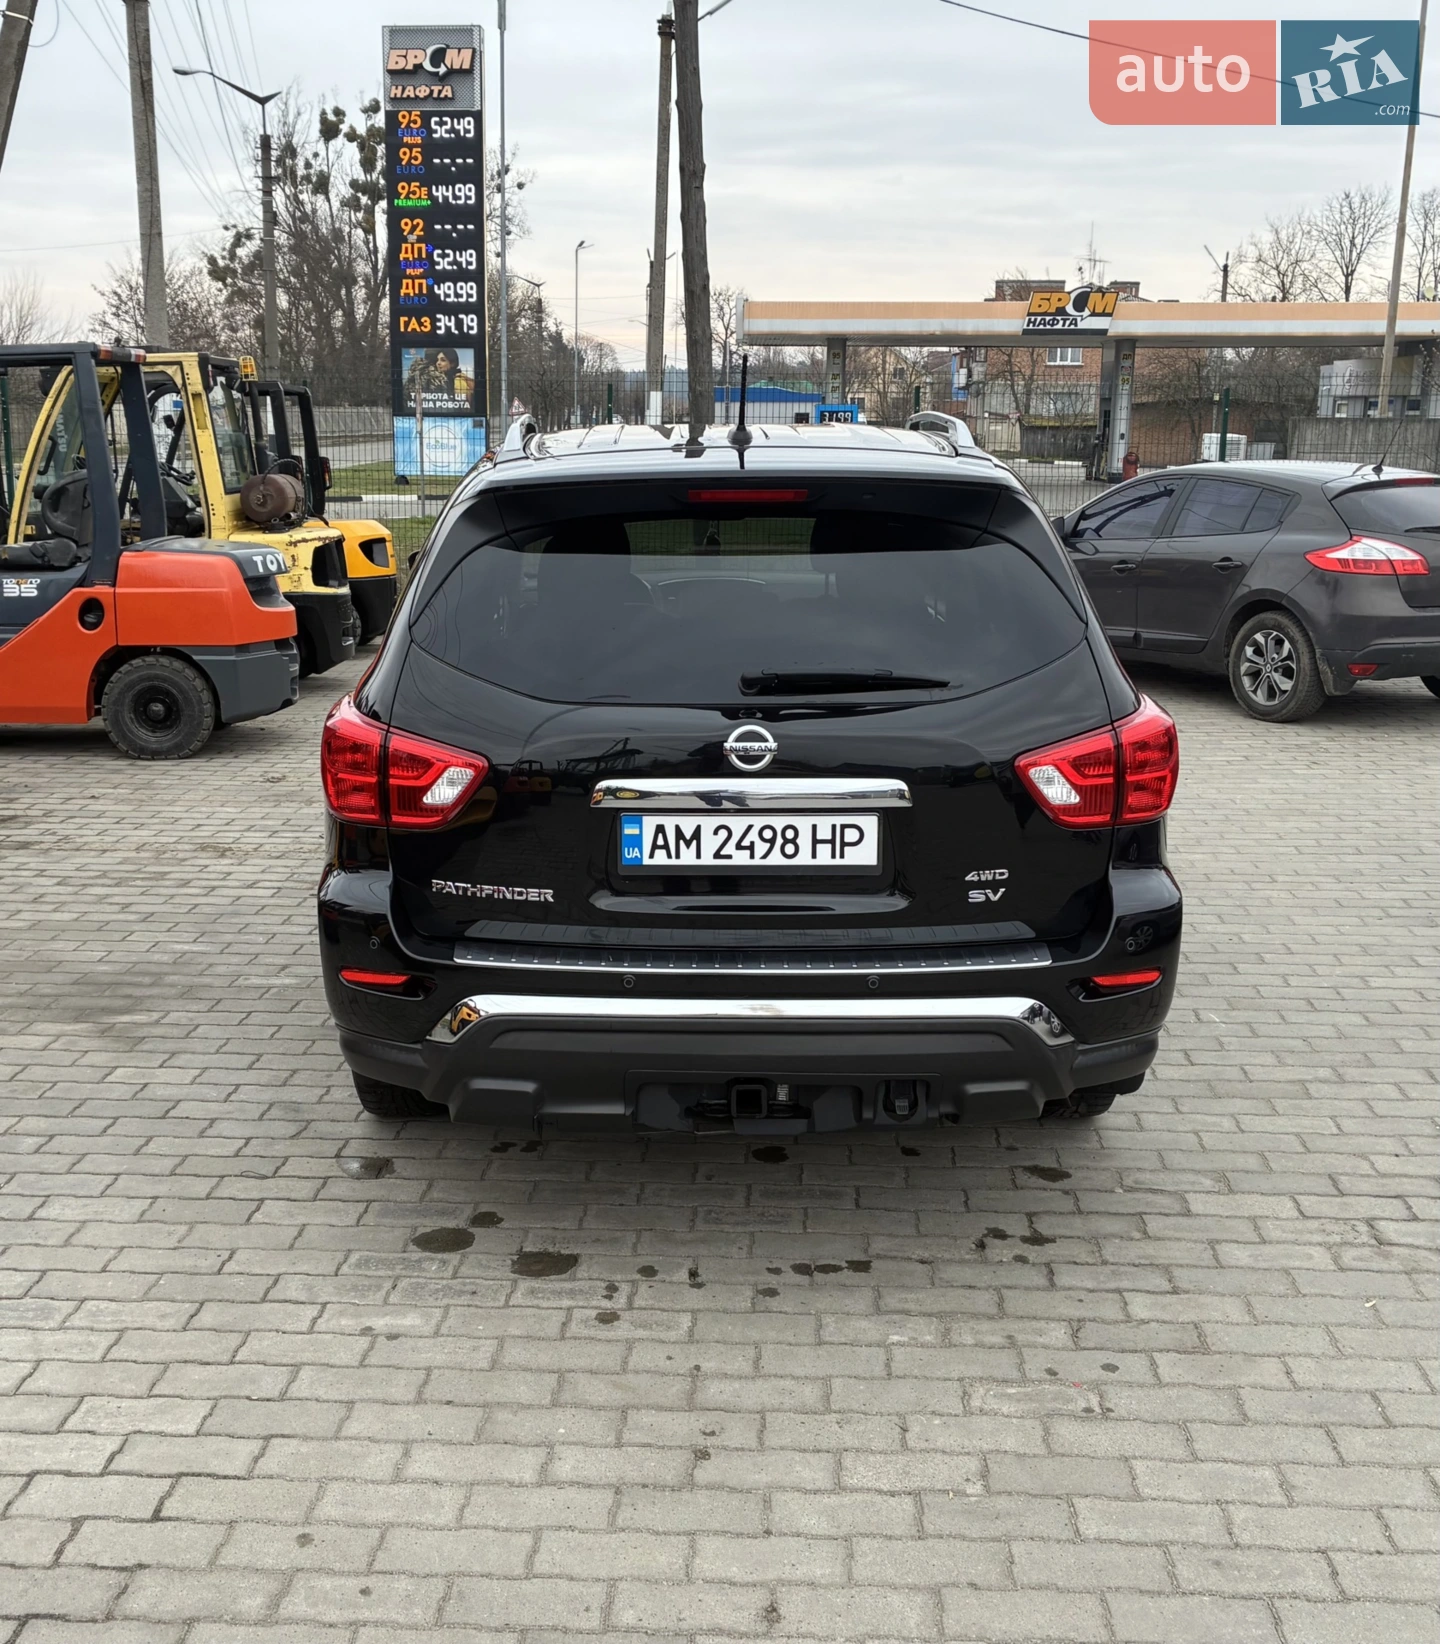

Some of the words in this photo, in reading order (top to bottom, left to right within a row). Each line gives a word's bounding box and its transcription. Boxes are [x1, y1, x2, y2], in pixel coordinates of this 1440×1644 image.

[389, 85, 453, 98] НАФТА
[397, 110, 422, 129] 95
[430, 116, 475, 138] 52.49
[397, 128, 427, 137] EURO
[403, 136, 422, 144] PLUS
[398, 147, 423, 166] 95
[396, 165, 425, 174] EURO
[432, 183, 475, 204] 44.99
[400, 217, 424, 236] 92
[399, 243, 427, 261] ДП
[433, 249, 477, 270] 52.49
[401, 260, 429, 269] EURO
[400, 278, 427, 297] ДП
[433, 281, 477, 302] 49.99
[399, 296, 428, 305] EURO
[400, 316, 431, 332] ГАЗ
[435, 313, 478, 335] 34.79
[1026, 317, 1078, 328] НАФТА
[410, 392, 449, 400] ТРБОТА
[455, 393, 467, 401] ЦЕ
[436, 401, 471, 409] РОБОТА
[3, 584, 38, 597] 35
[728, 744, 774, 753] NISSAN
[624, 848, 641, 859] UA
[648, 824, 701, 860] AM
[712, 824, 800, 860] 2498
[811, 824, 865, 860] HP
[965, 868, 1009, 881] 4WD
[431, 879, 554, 902] PATHFINDER
[968, 888, 1006, 903] SV
